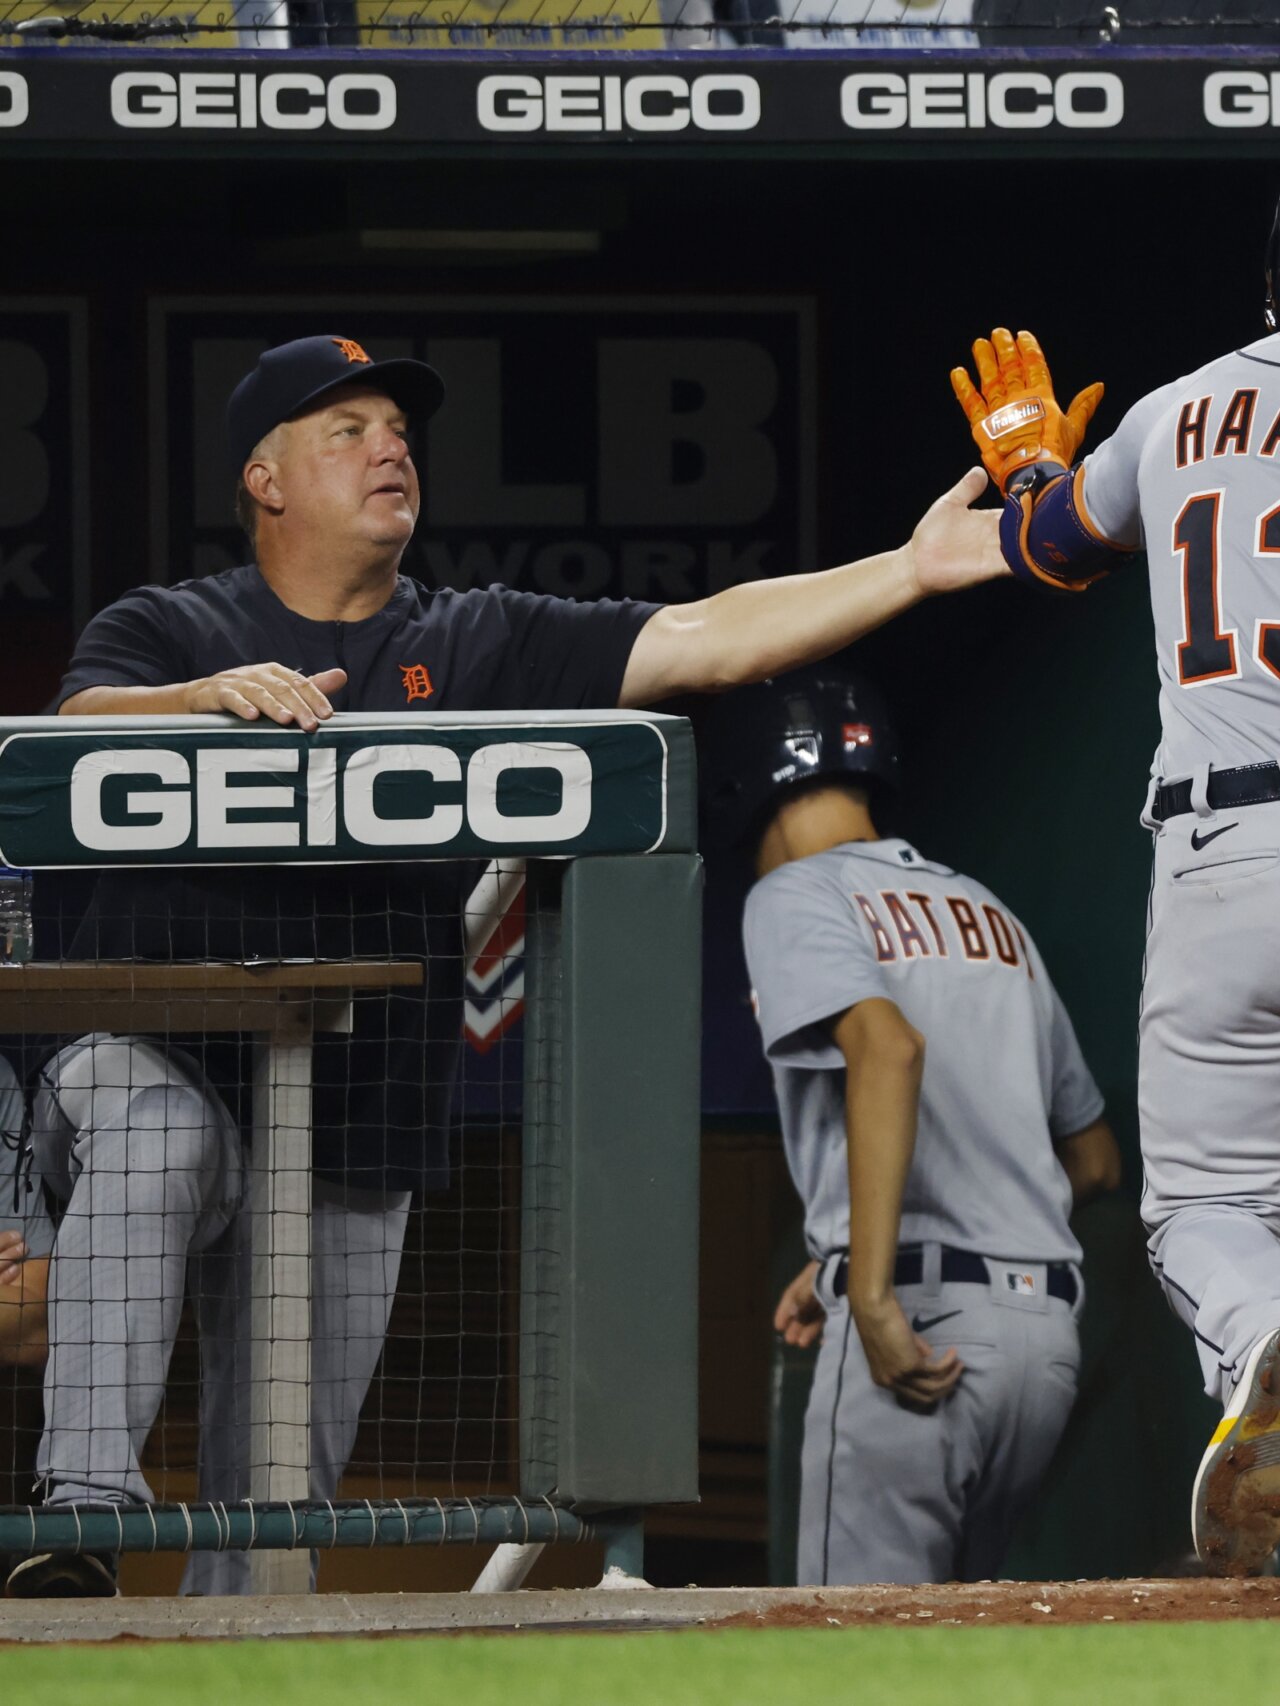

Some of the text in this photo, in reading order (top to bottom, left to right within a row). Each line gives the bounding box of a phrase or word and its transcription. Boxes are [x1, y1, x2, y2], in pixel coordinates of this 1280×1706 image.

[110, 72, 397, 130] GEICO
[477, 74, 761, 132] GEICO
[840, 72, 1124, 129] GEICO
[331, 337, 370, 364] D
[398, 663, 434, 704] D
[70, 740, 594, 852] GEICO
[853, 889, 948, 962] BAT
